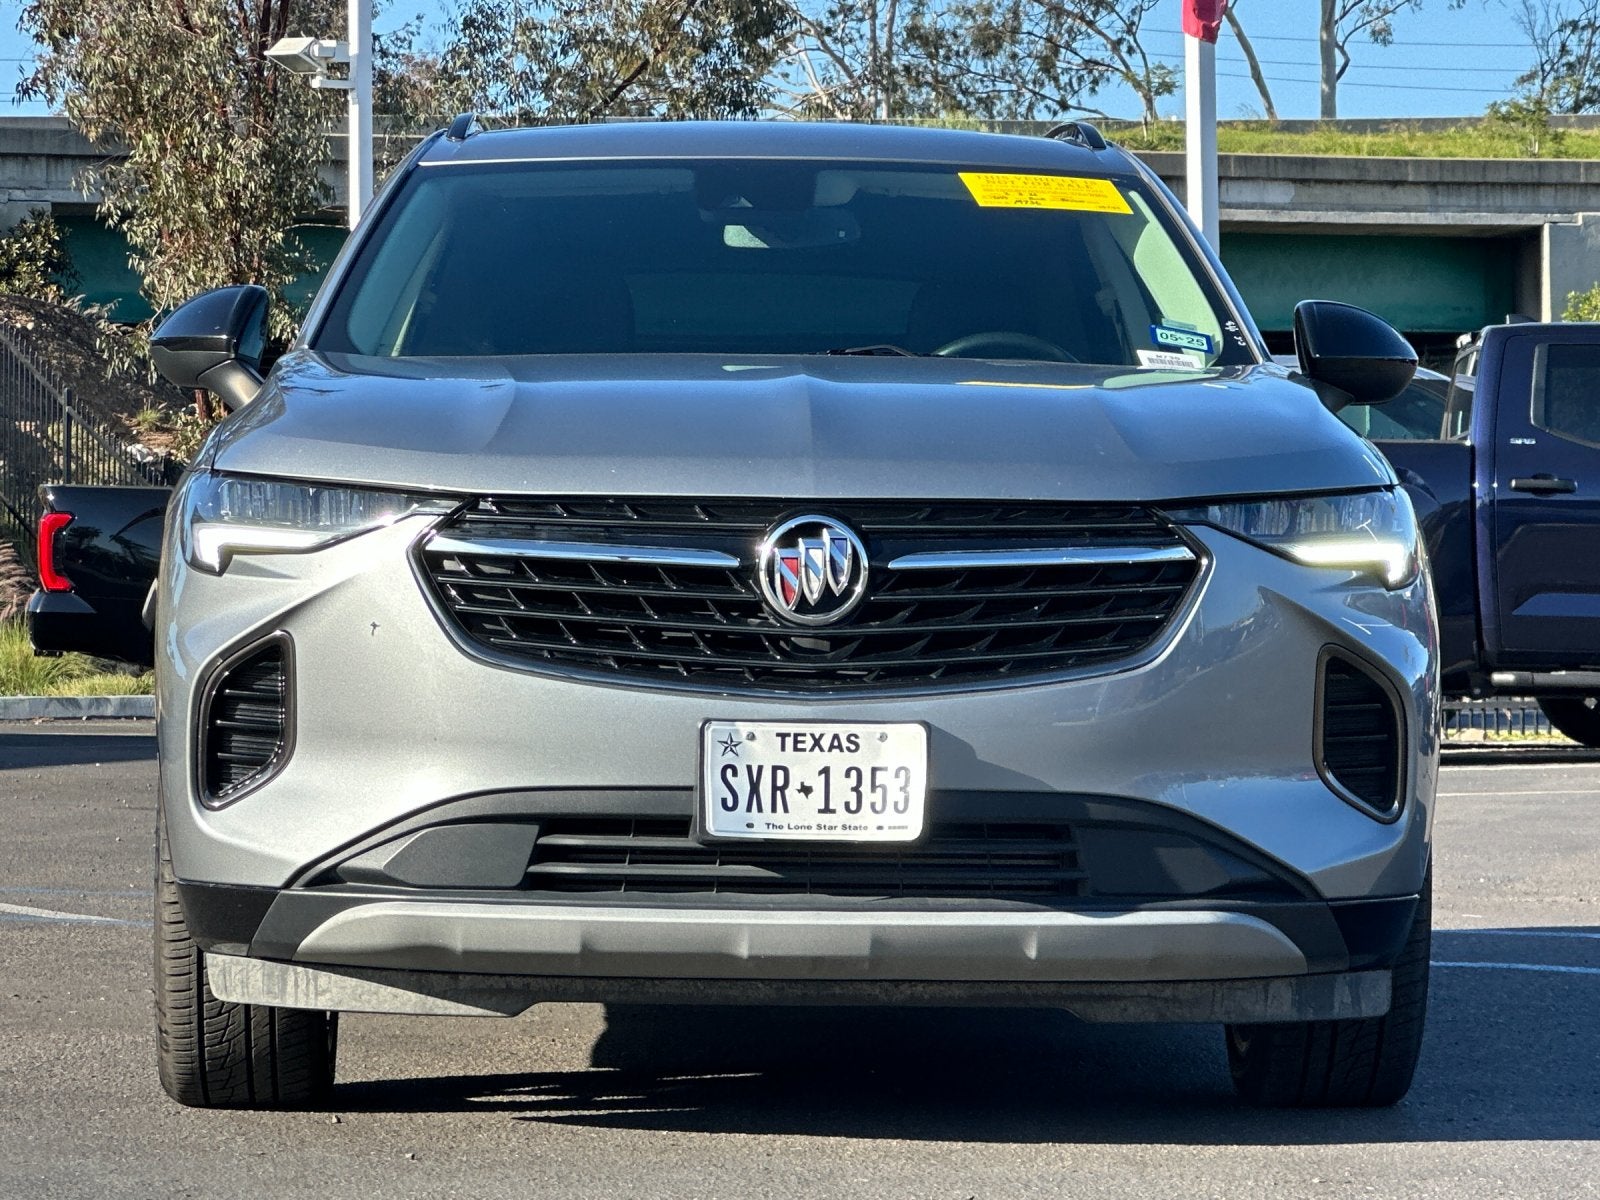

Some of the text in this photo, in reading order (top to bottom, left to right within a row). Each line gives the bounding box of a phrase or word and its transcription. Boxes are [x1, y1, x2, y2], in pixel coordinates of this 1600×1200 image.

[1159, 331, 1205, 347] 05-25
[775, 732, 861, 753] TEXAS
[720, 763, 912, 815] SXR 1353
[764, 822, 868, 832] The Lone Star State
